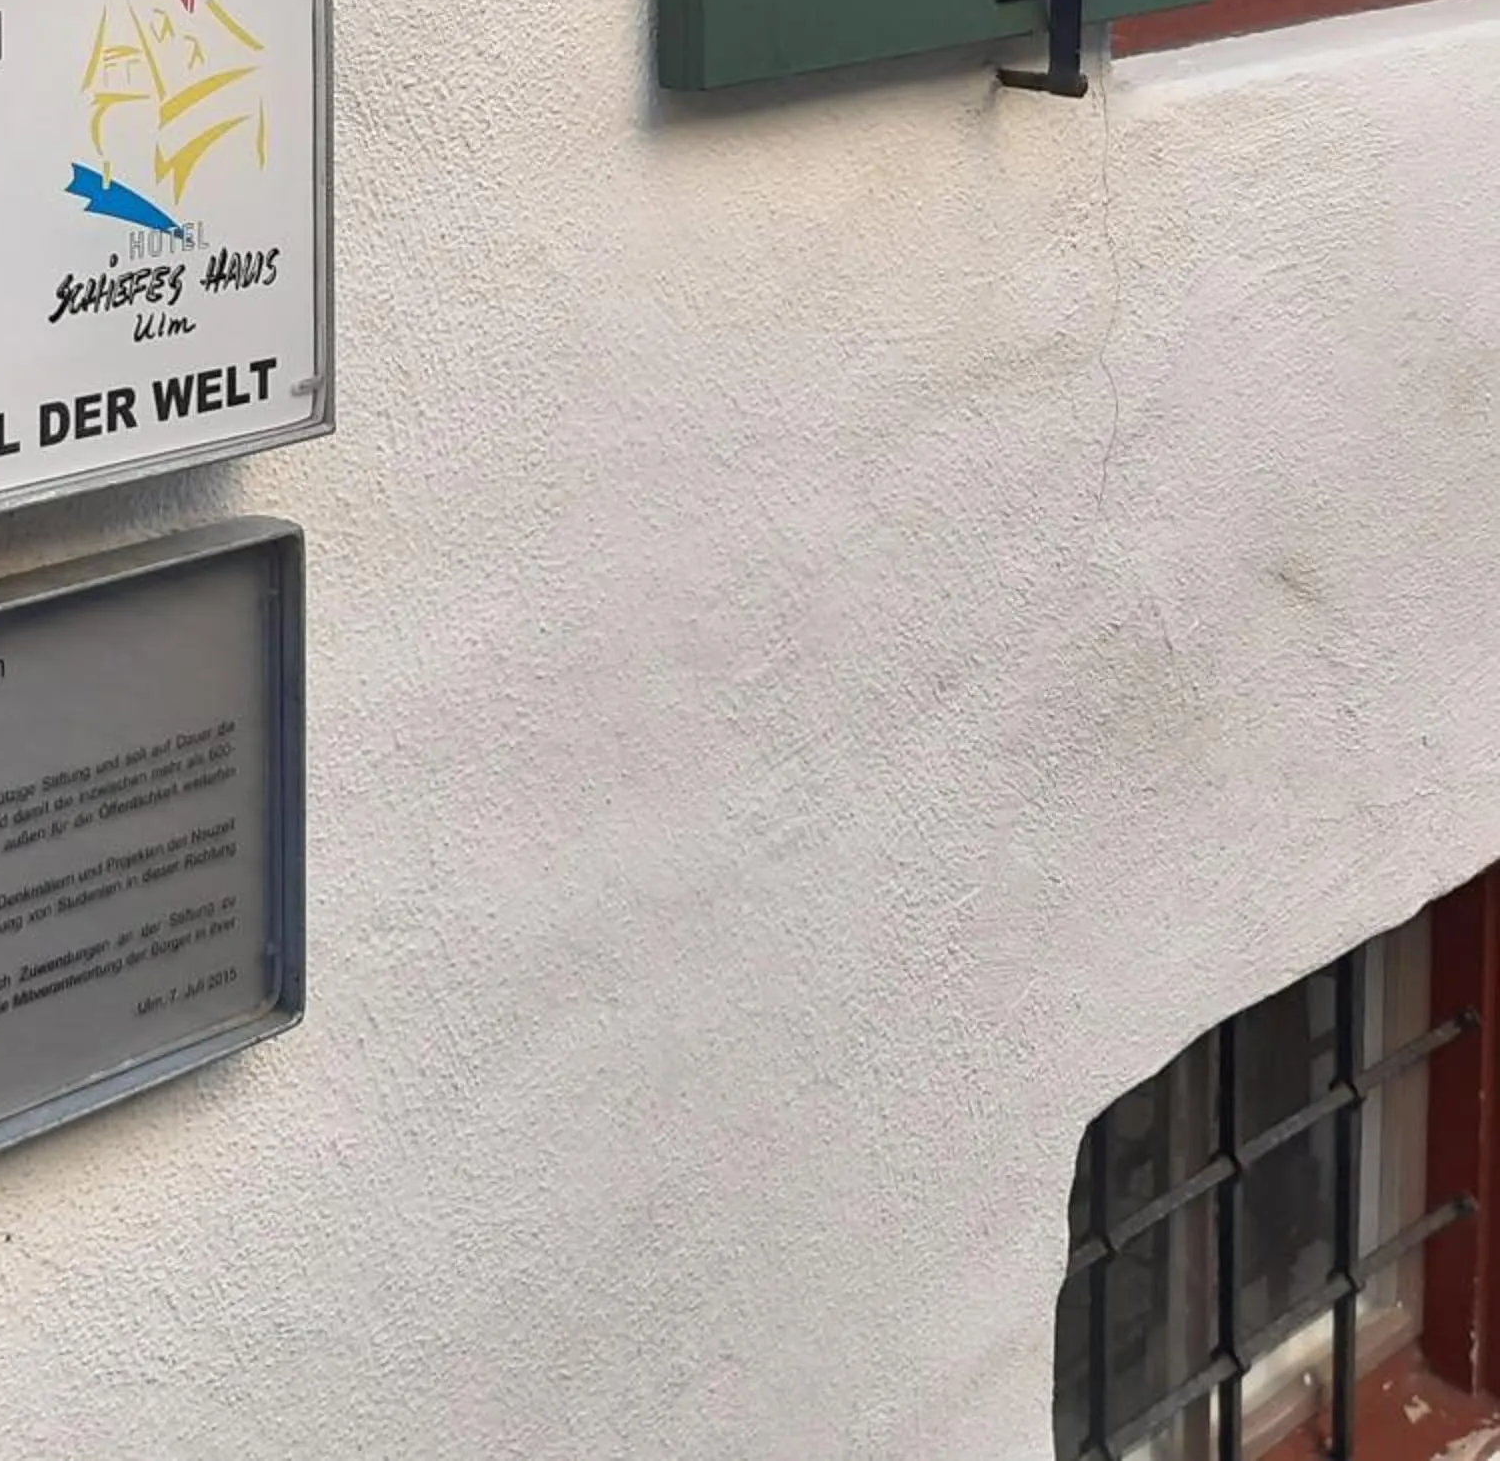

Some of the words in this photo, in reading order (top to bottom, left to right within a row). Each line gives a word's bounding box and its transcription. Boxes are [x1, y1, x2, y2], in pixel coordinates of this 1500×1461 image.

[129, 220, 210, 261] HOTEL
[133, 312, 197, 343] Ulm
[39, 387, 137, 447] DER
[152, 357, 276, 422] WELT
